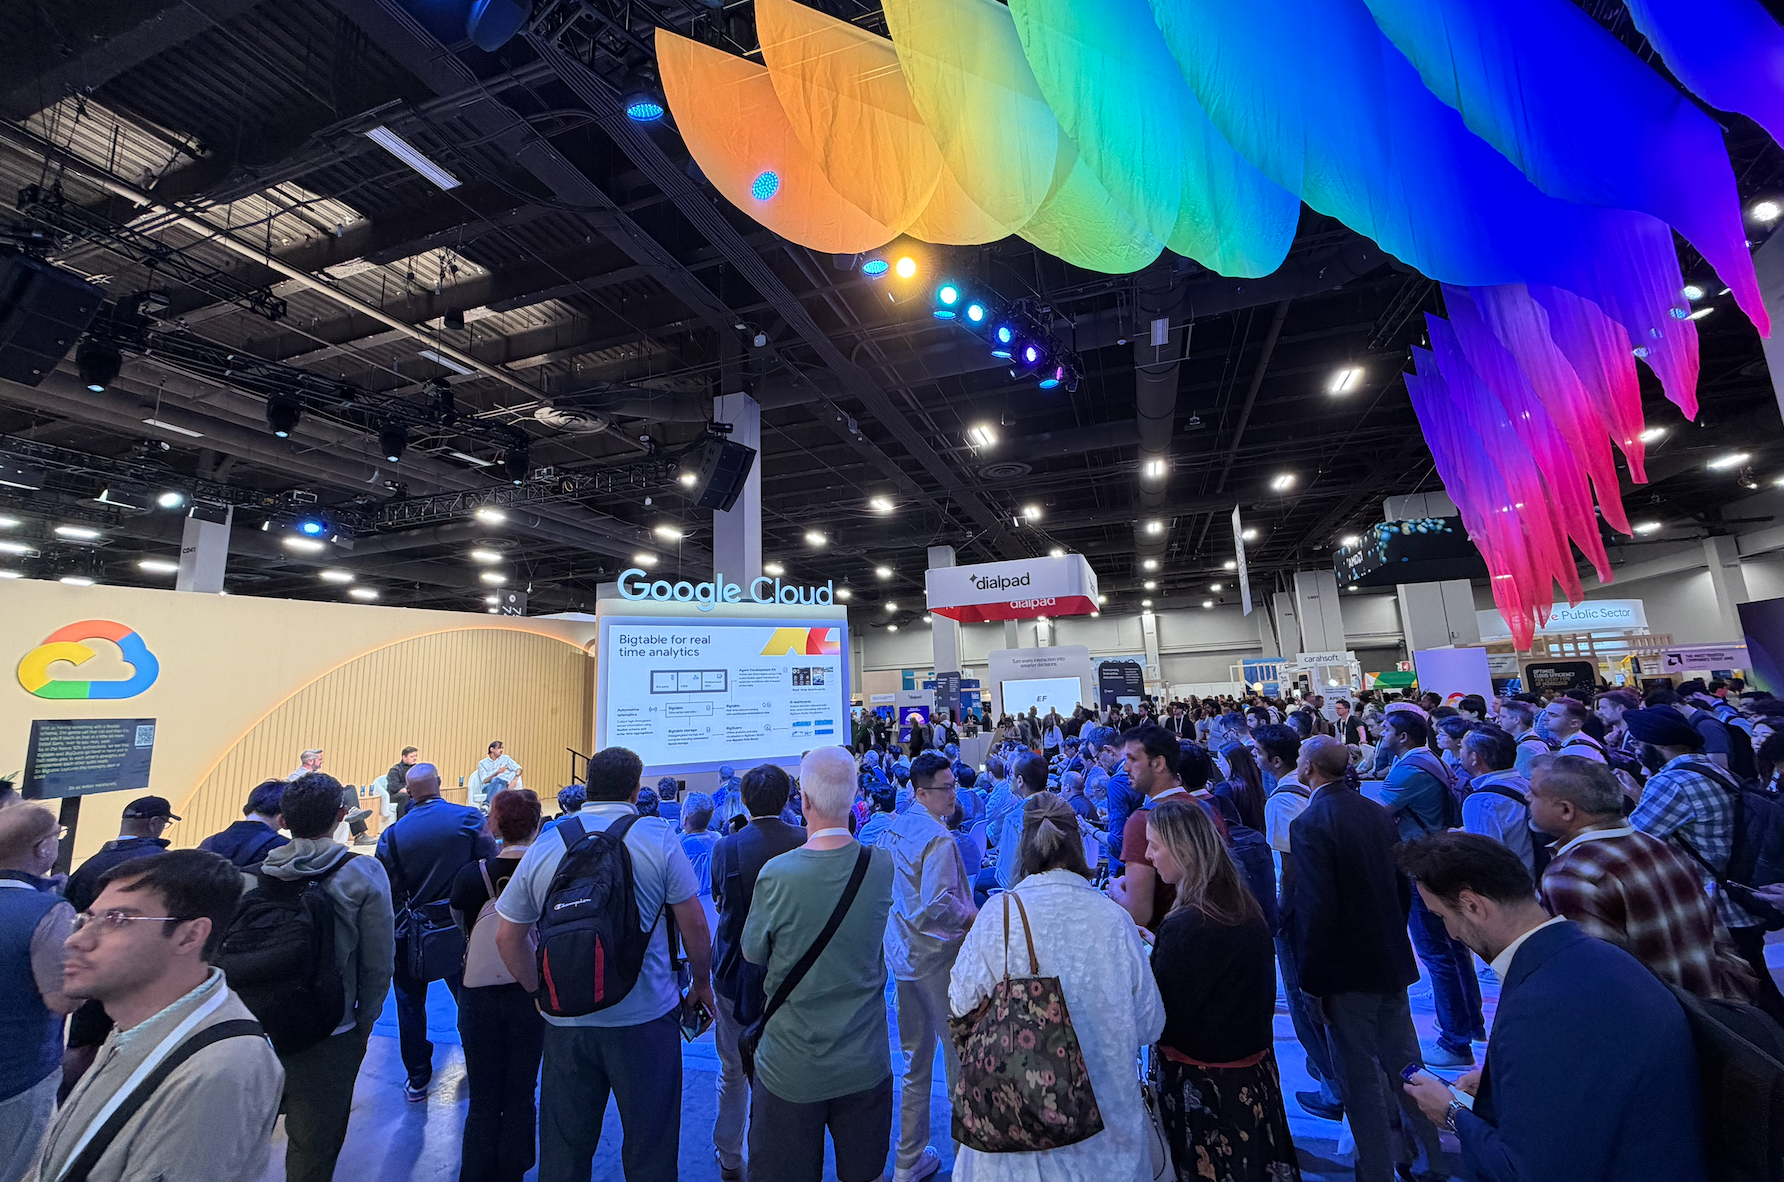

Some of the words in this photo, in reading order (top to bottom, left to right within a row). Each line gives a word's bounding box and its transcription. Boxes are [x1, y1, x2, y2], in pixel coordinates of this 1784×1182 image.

[976, 572, 1030, 590] dialpad
[617, 568, 742, 611] Google
[750, 576, 833, 605] Cloud
[1010, 598, 1056, 610] dialpad
[1562, 609, 1598, 620] Public
[1600, 608, 1630, 618] Sector
[619, 635, 668, 646] Bigtable
[671, 635, 687, 644] for
[690, 635, 711, 644] real
[619, 647, 646, 657] time
[649, 647, 700, 659] analytics
[554, 898, 591, 910] Champion
